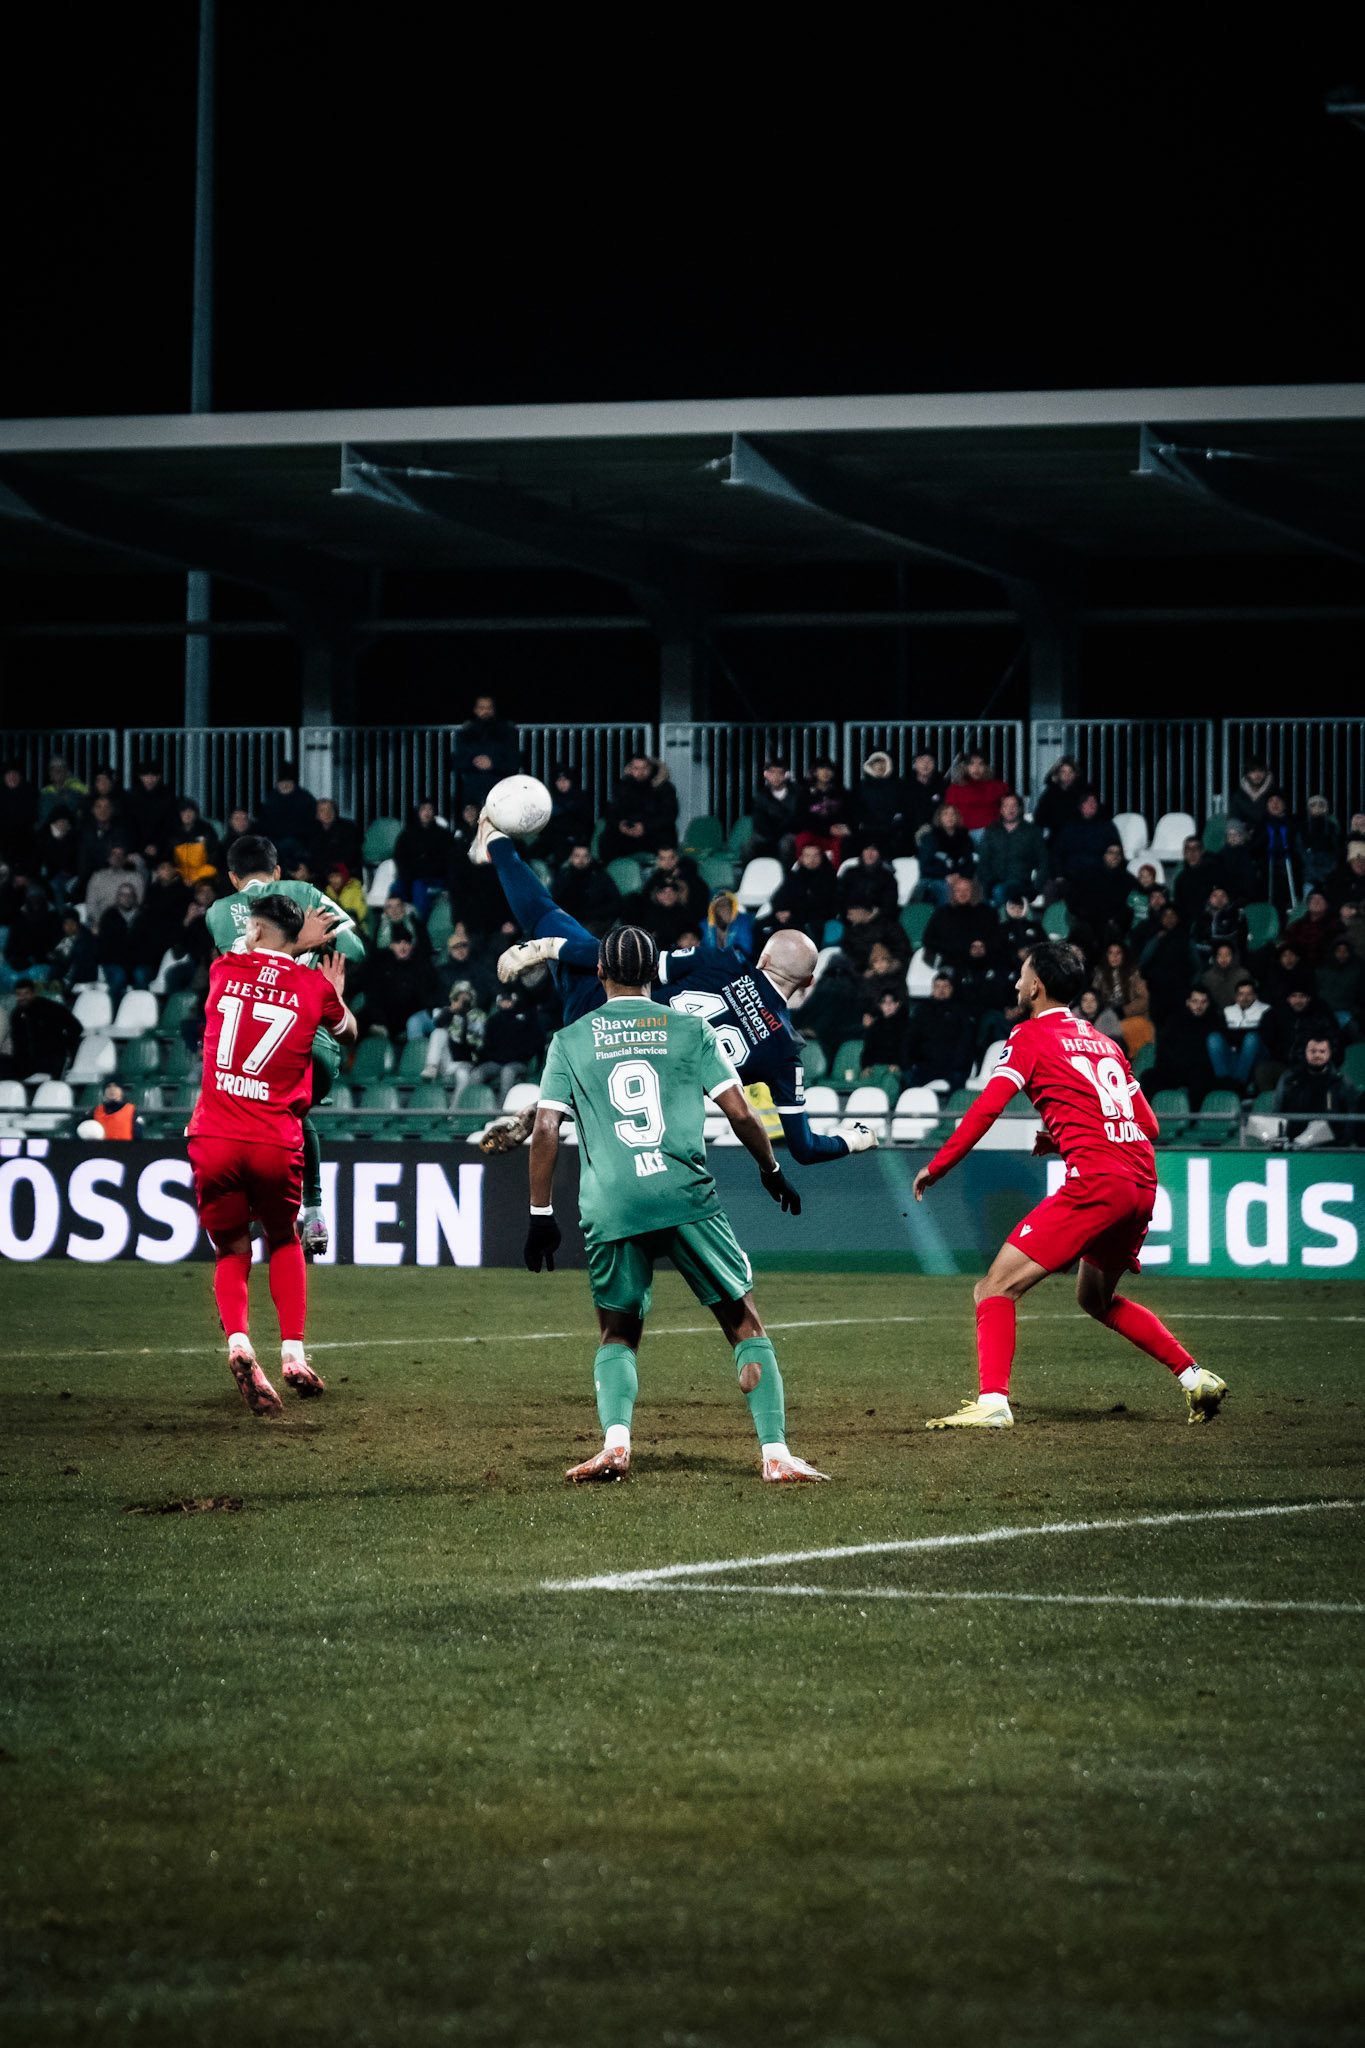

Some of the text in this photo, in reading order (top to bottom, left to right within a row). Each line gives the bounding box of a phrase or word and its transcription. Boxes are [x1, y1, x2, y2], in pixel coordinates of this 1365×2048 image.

[224, 980, 299, 1008] HESTIA
[721, 986, 759, 1045] Financial Services
[731, 979, 770, 1040] Partners
[216, 995, 298, 1076] 17
[593, 1030, 667, 1047] Partners
[1061, 1038, 1116, 1054] HESTIA
[595, 1047, 668, 1060] Financial Services
[607, 1059, 666, 1148] 9
[634, 1148, 668, 1177] AKÉ
